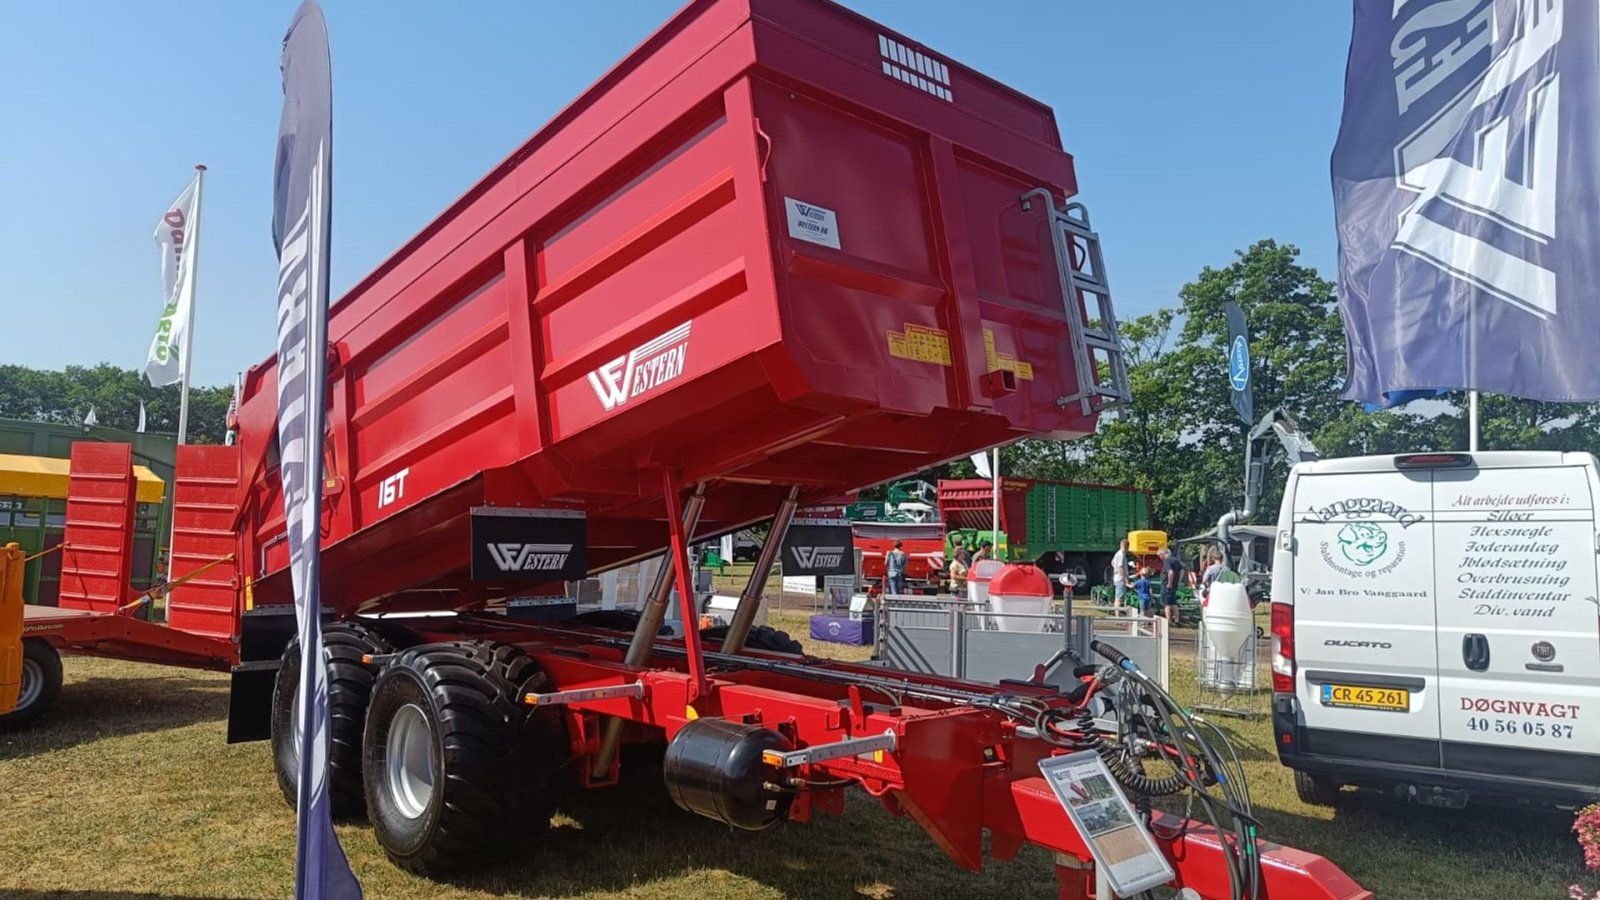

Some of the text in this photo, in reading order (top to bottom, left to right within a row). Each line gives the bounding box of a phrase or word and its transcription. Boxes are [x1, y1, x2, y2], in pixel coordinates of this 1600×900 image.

[587, 320, 691, 411] WESTERN
[378, 467, 409, 509] 16T
[1452, 494, 1471, 507] Alt
[1473, 494, 1515, 507] arbejde
[1516, 493, 1559, 507] udføres
[1301, 497, 1425, 529] Vanggaard
[1487, 510, 1534, 521] Siloer
[487, 543, 573, 571] WESTERN
[791, 547, 845, 568] WESTERN
[1465, 541, 1560, 555] Foderanlæg
[1320, 541, 1406, 579] Staldmontage og reparation
[1457, 572, 1570, 588] Overbrusning
[1315, 588, 1335, 596] Jan
[1363, 589, 1427, 598] Vanggaard
[1458, 588, 1571, 601] Staldinventar
[1324, 639, 1392, 649] DUCATO
[1332, 688, 1404, 705] CR 45 261
[1460, 697, 1580, 719] DØGNVAGT
[1467, 717, 1573, 739] 40 56 05 87
